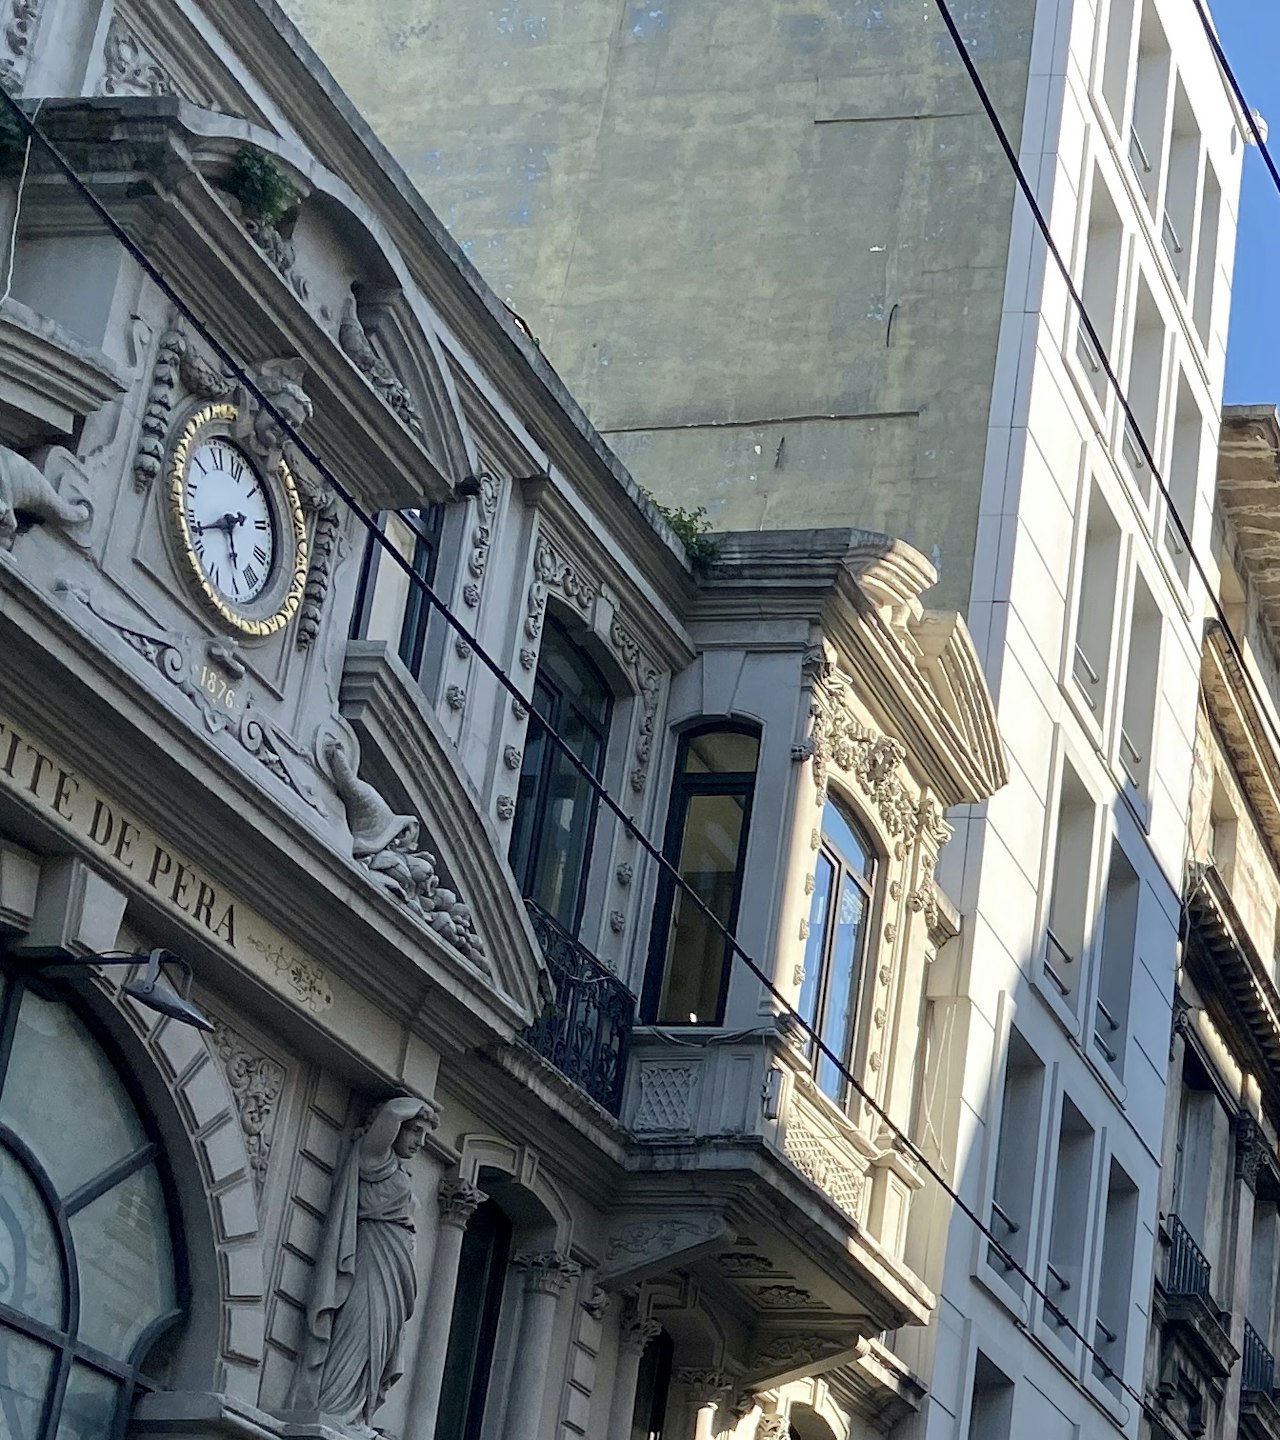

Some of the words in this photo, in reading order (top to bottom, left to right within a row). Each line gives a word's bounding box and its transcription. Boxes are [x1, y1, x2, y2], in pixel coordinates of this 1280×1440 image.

[199, 665, 235, 709] 1876
[0, 723, 80, 822] ITÉ
[86, 797, 141, 870] DE
[145, 842, 237, 949] PÉRA
